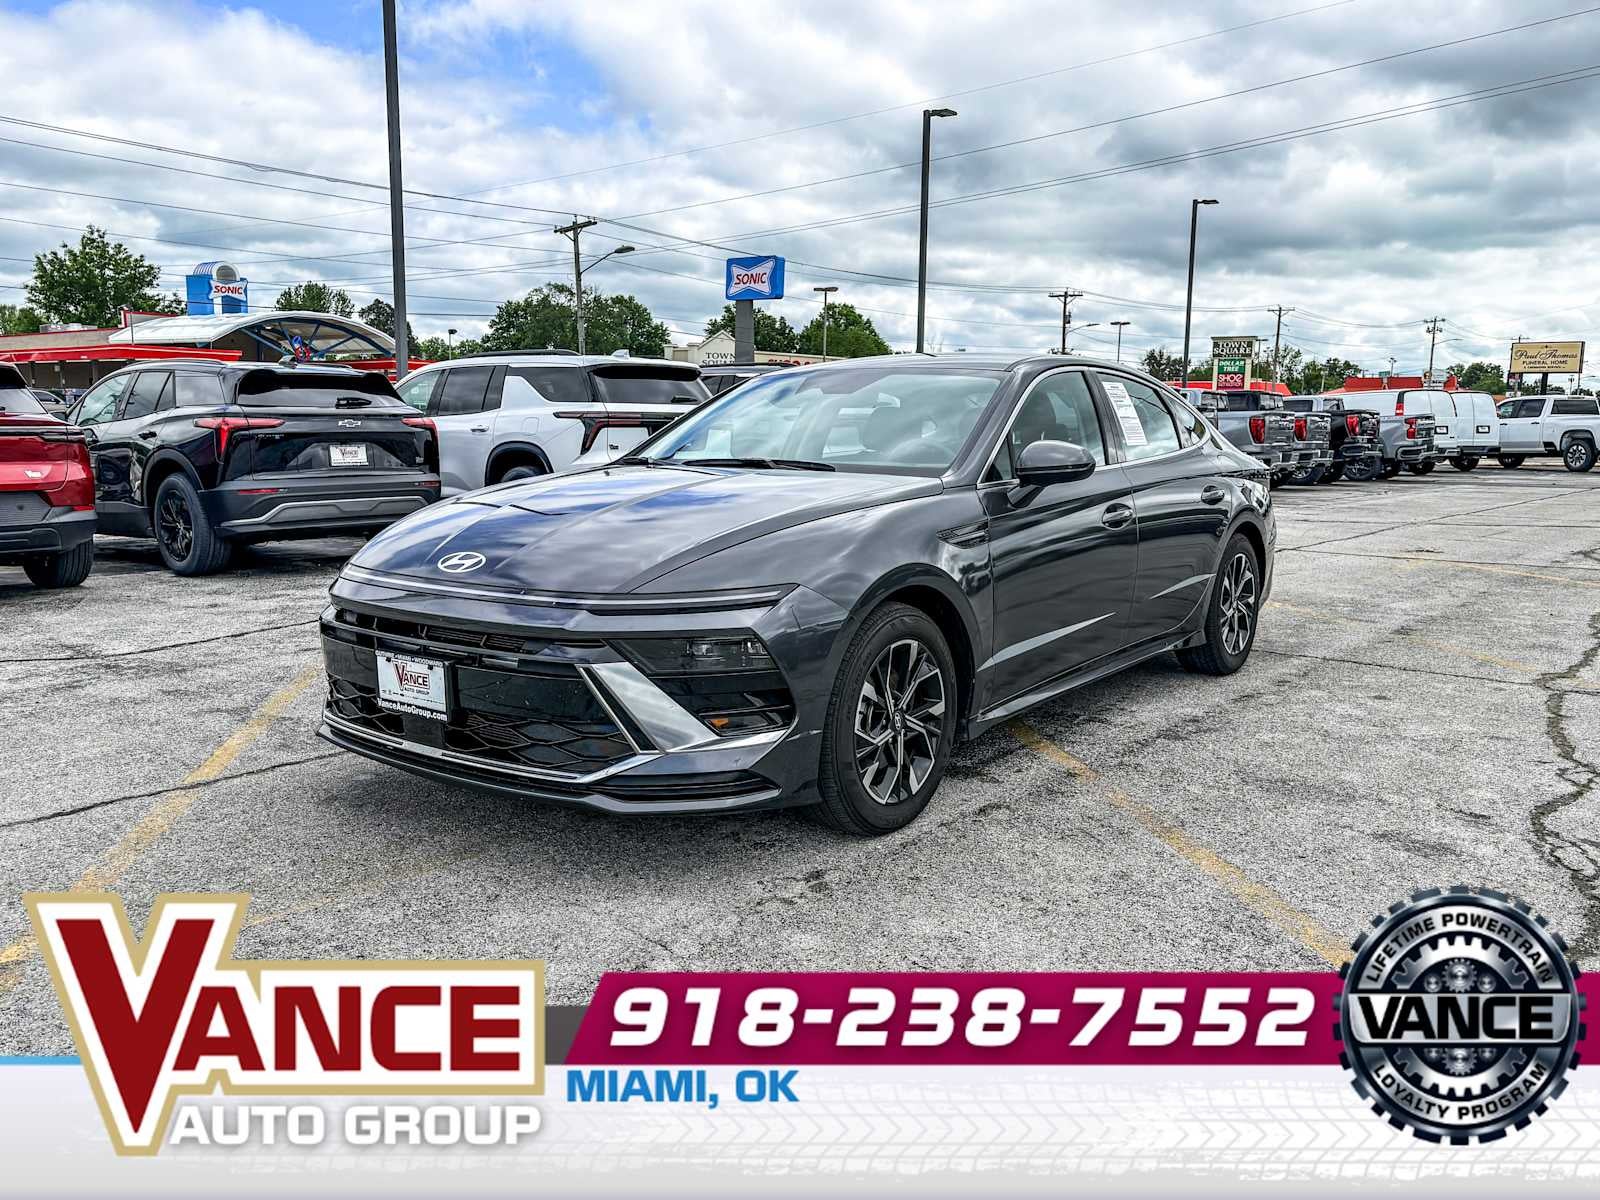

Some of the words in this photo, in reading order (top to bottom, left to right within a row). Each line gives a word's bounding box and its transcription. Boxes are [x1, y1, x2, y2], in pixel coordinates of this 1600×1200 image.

[734, 272, 767, 285] SONIC
[213, 285, 243, 295] SONIC
[1514, 349, 1540, 361] Paul
[1540, 349, 1578, 360] Thomas
[394, 662, 429, 689] VANCE
[377, 698, 448, 721] VanceAutoGroup.com
